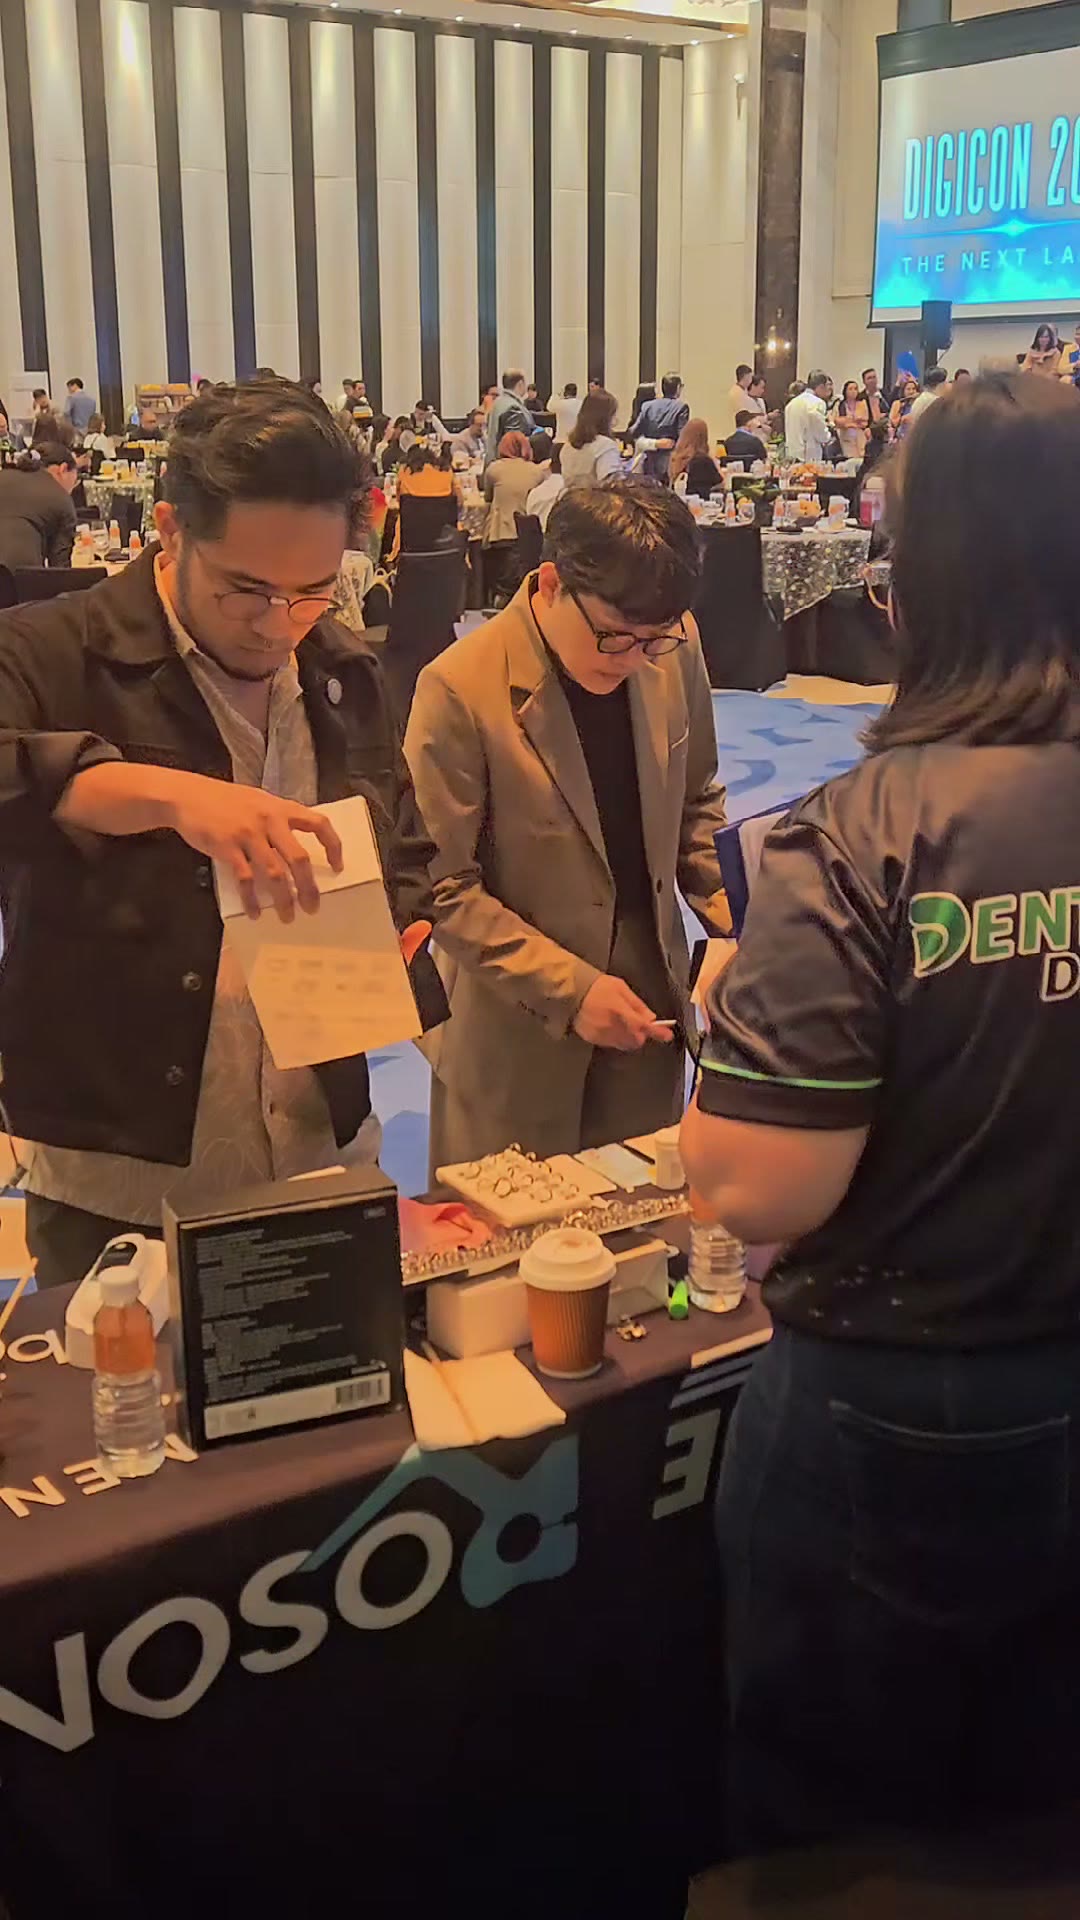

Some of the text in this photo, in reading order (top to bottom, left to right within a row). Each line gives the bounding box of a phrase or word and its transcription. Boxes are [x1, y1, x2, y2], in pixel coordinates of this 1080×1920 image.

[902, 122, 1033, 221] DIGICON
[902, 255, 946, 275] THE
[961, 248, 1027, 271] NEXT
